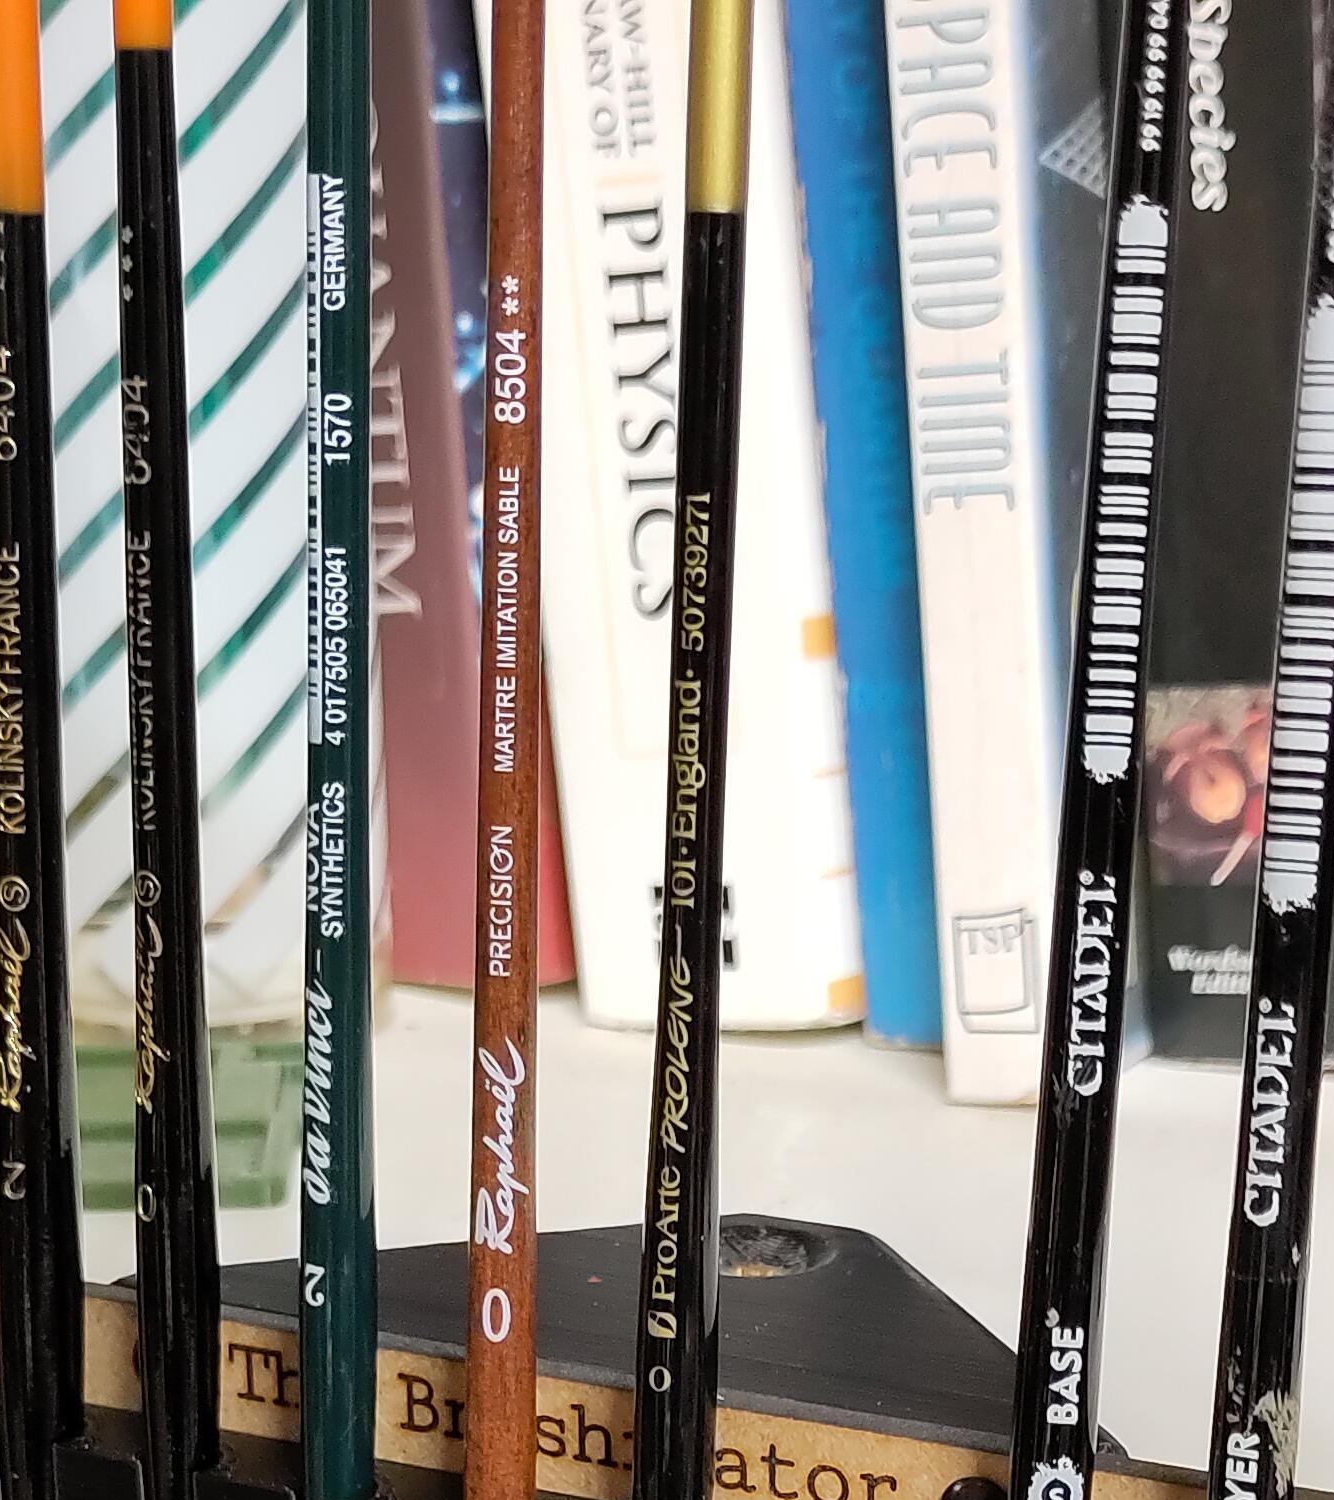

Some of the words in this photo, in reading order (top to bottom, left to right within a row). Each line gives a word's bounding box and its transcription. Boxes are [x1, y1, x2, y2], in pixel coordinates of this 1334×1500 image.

[321, 172, 347, 313] GERMANY
[907, 196, 1005, 330] AND
[324, 393, 353, 466] 1570
[493, 328, 527, 425] 8504
[601, 203, 678, 622] PHYSICS
[917, 346, 1015, 517] TIME
[498, 466, 520, 546] SABLE
[323, 546, 347, 632] 065041
[496, 550, 520, 671] IMITATION
[680, 490, 711, 653] 50739271
[323, 636, 347, 725] 017505
[324, 731, 345, 747] 4
[493, 675, 517, 774] MARTRE
[671, 679, 705, 841] England
[320, 780, 346, 940] SYNTHETICS
[488, 825, 514, 978] PRECISION
[1066, 870, 1117, 1097] CITADEL
[660, 955, 694, 1154] PROLENE
[1243, 1000, 1297, 1228] CITADEL
[2, 1161, 28, 1202] 2
[473, 1036, 527, 1256] Raphaël
[305, 1263, 326, 1307] 2
[481, 1287, 511, 1343] 0
[228, 1343, 300, 1409] Th
[1047, 1325, 1085, 1426] BASE
